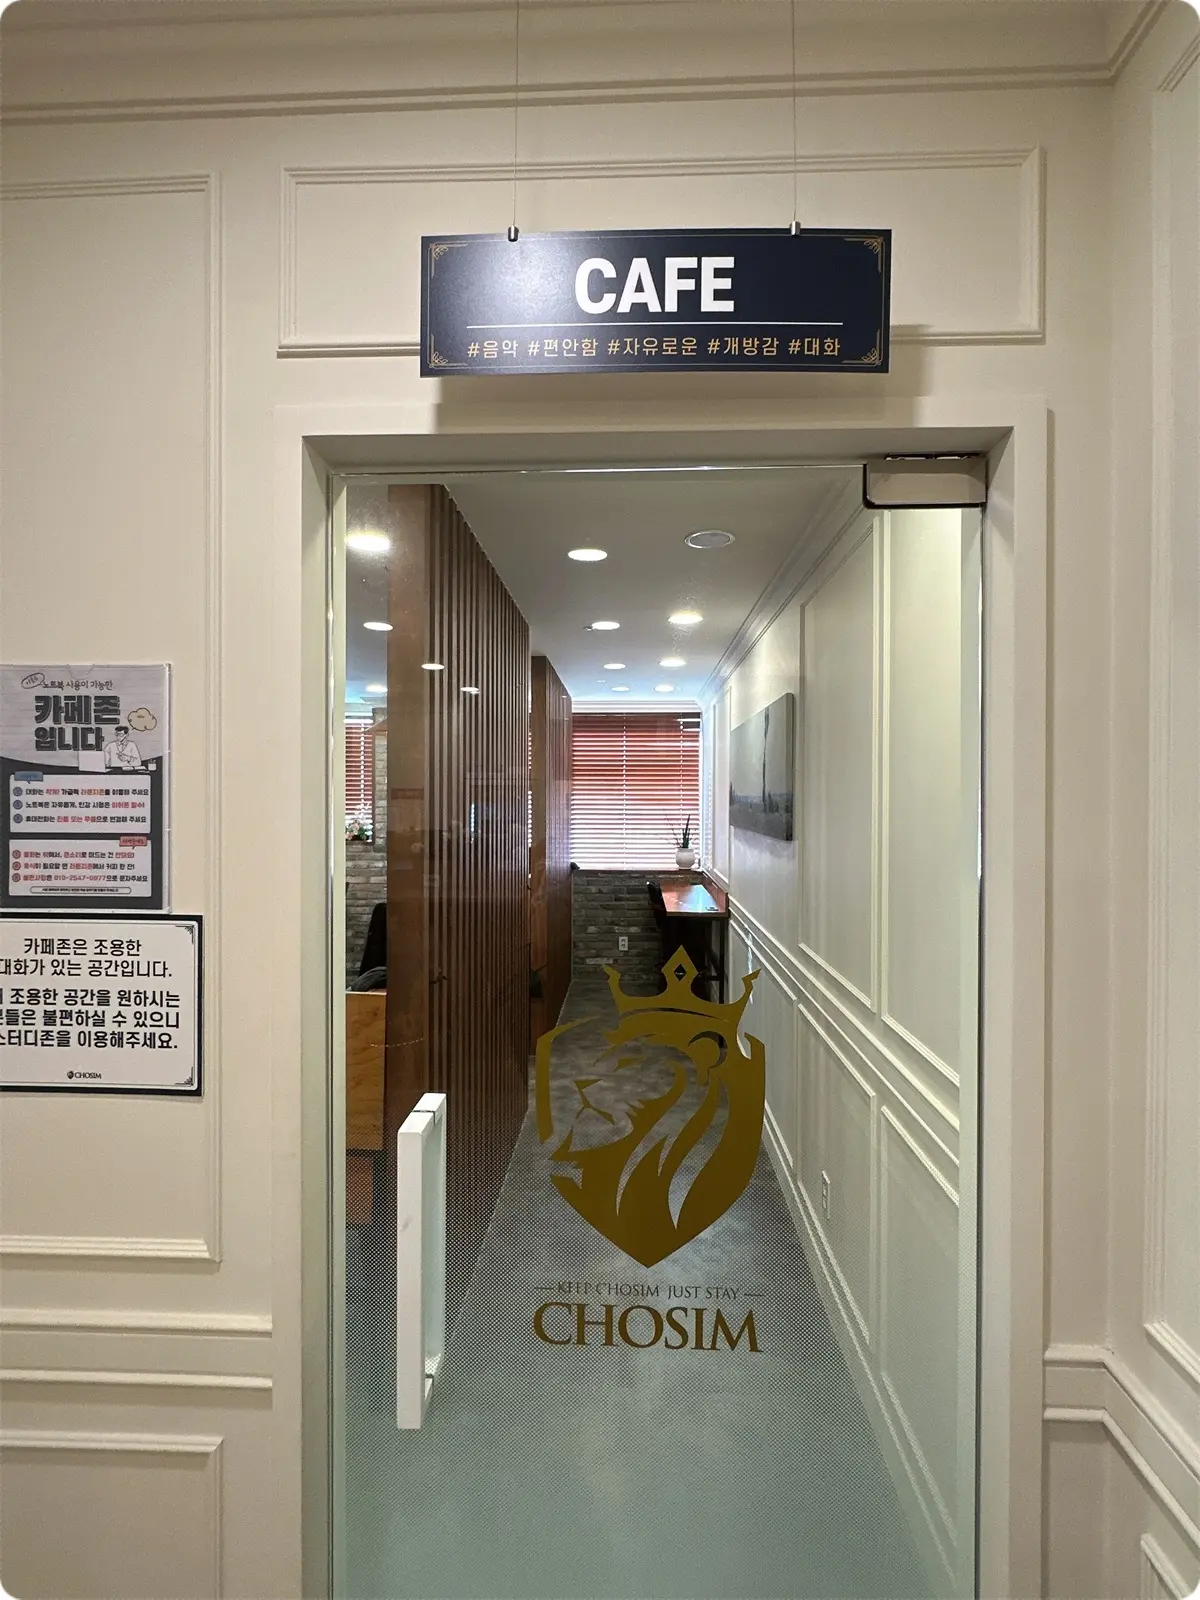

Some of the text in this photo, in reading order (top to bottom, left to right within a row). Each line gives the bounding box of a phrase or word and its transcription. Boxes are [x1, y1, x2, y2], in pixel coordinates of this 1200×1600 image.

[574, 256, 735, 315] CAFE
[467, 337, 841, 359] #음악 #편안함 #자유로운 #개방감 #대화
[43, 681, 65, 691] 노트북
[66, 681, 89, 690] 사용이
[34, 695, 121, 725] 카페존
[34, 726, 105, 752] 입니다
[25, 788, 44, 796] 대화는
[131, 788, 149, 796] 주세요
[25, 801, 50, 809] 노트북은
[25, 815, 56, 823] 휴대전화는
[70, 815, 83, 823] 또는
[24, 938, 142, 957] 카페존은 조용한
[0, 958, 173, 978] 대화가 있는 공간입니다.
[10, 988, 59, 1007] 조용한
[63, 988, 111, 1007] 공간을
[116, 989, 181, 1008] 원하시는
[0, 1009, 180, 1029] 들은 불편하실 수 있으니
[77, 1030, 178, 1050] 이용해주세요.
[74, 1071, 102, 1080] CHOSIM
[596, 1283, 660, 1298] CHOSIM
[667, 1285, 701, 1300] JUST
[705, 1286, 740, 1301] STAY
[533, 1301, 764, 1353] CHOSIM
